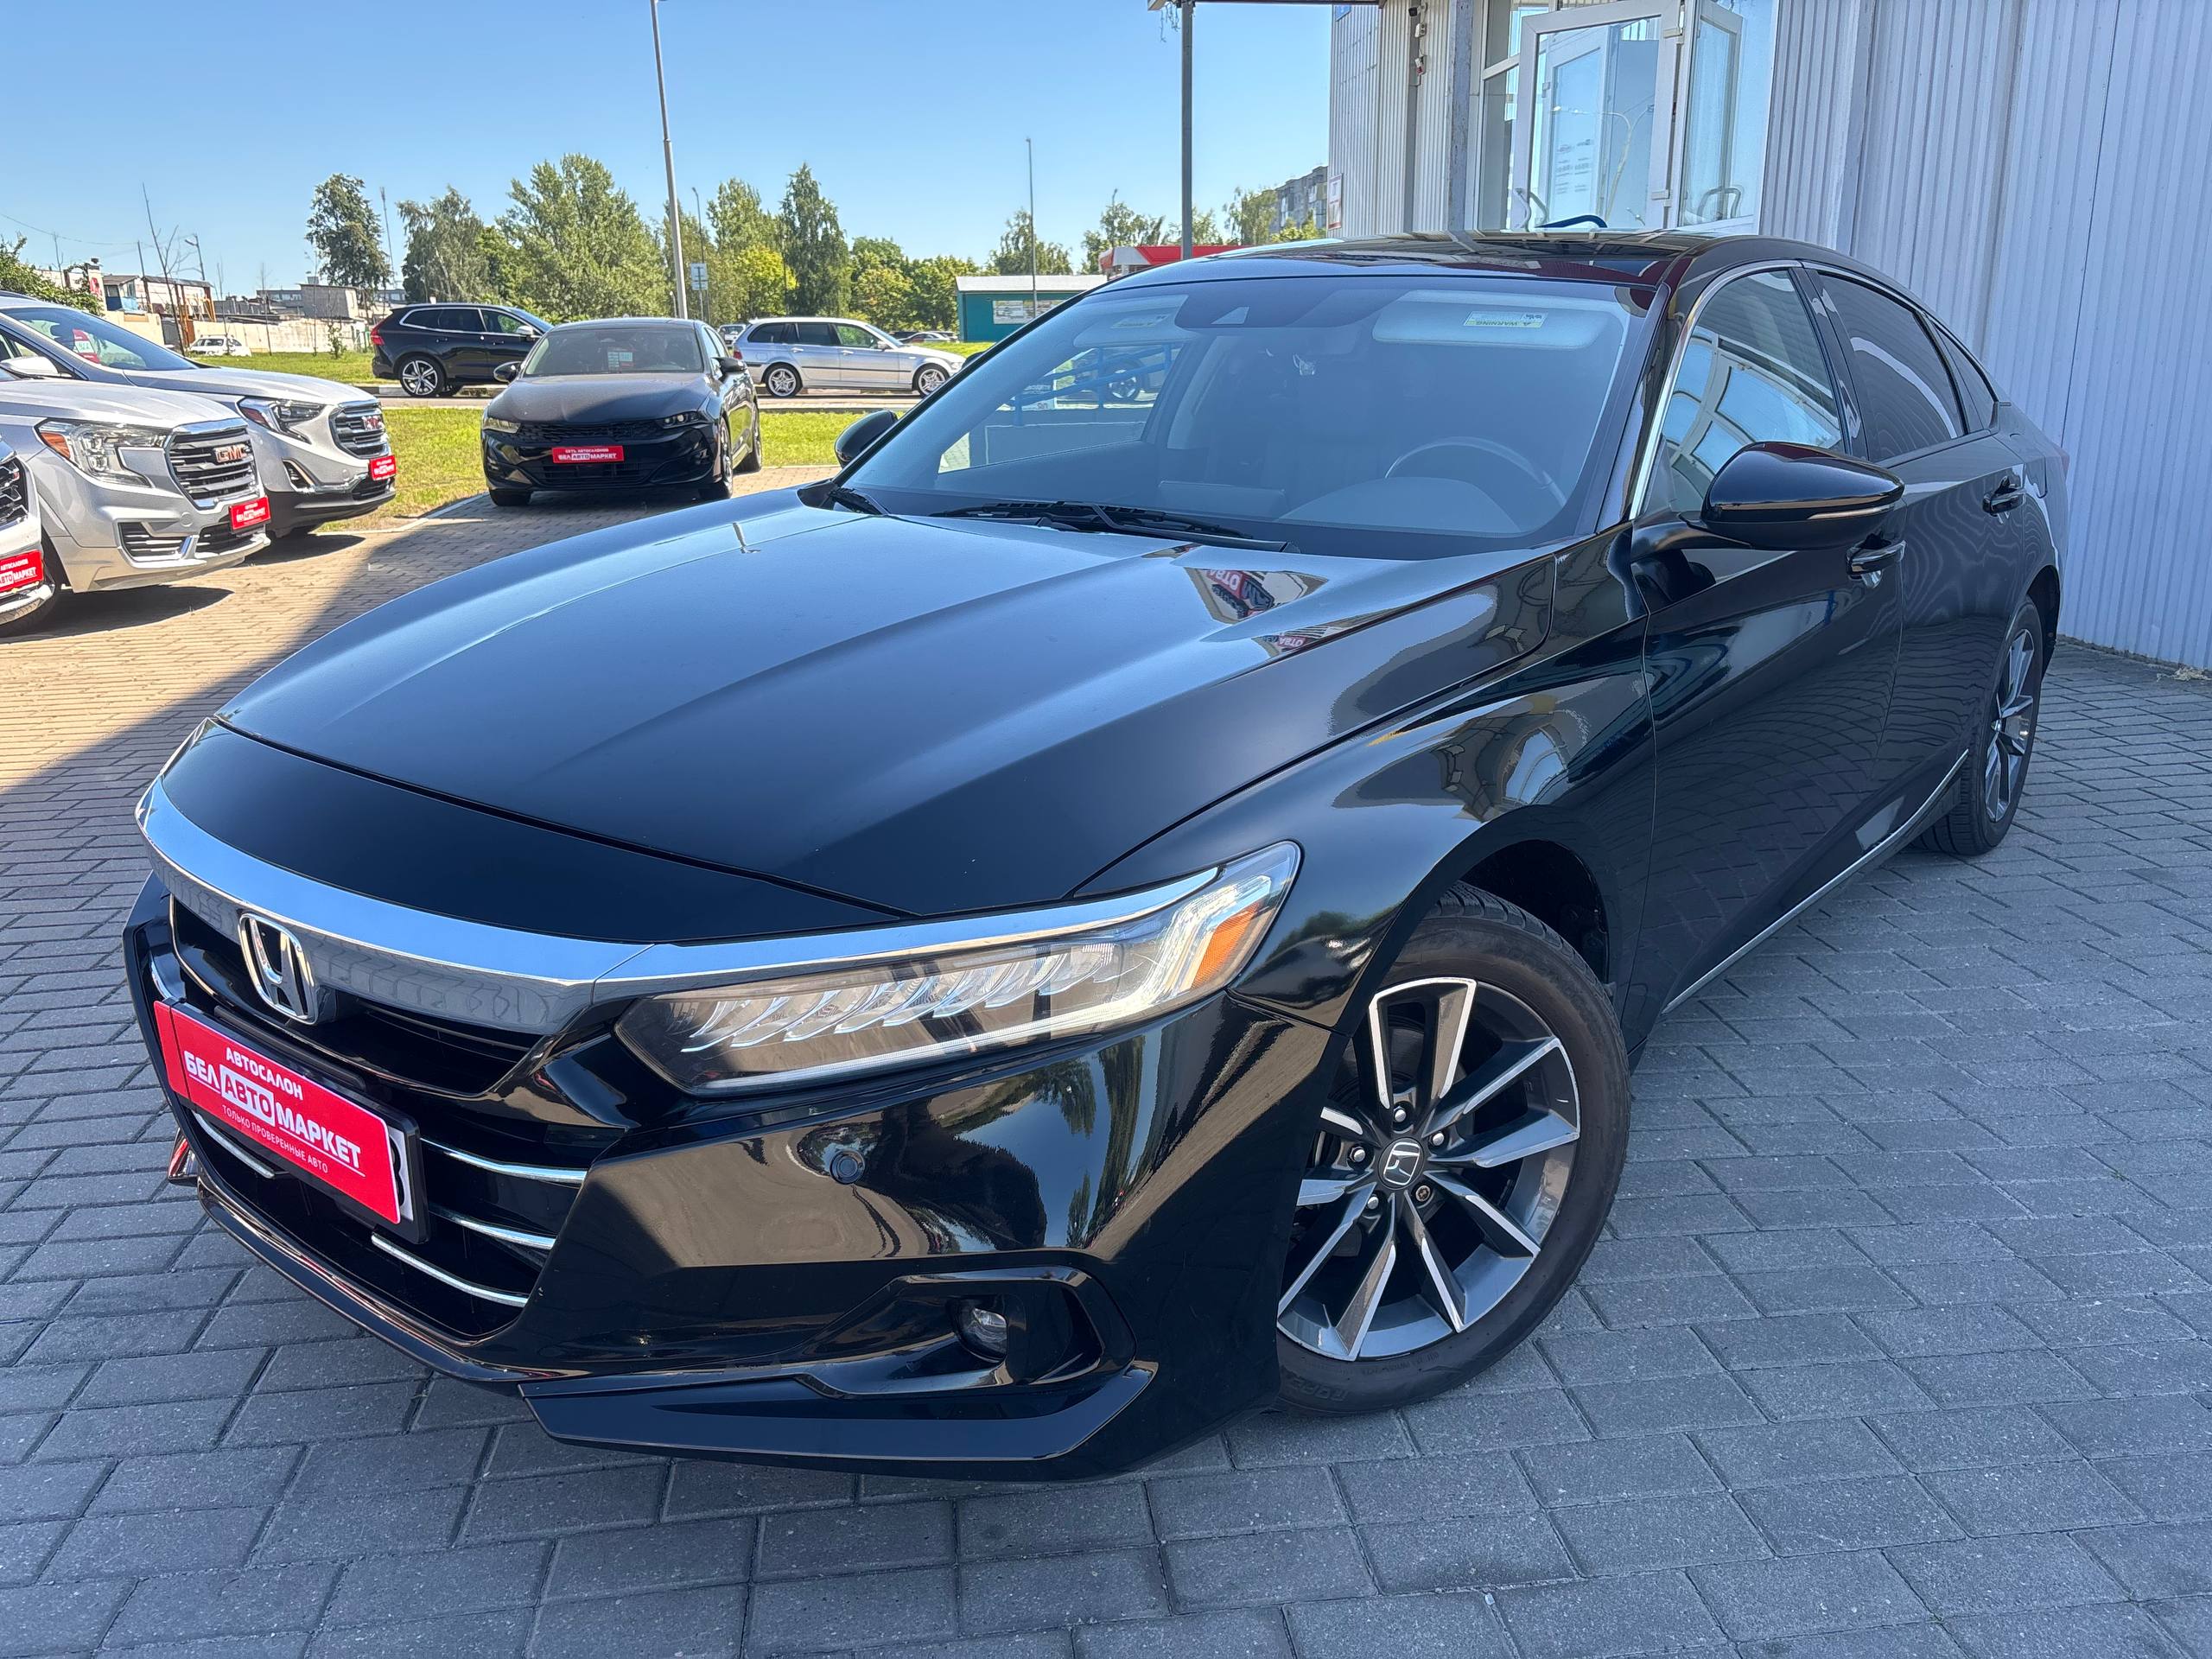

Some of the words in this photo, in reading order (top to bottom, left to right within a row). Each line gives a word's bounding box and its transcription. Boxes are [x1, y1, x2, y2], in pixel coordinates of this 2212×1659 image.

[213, 444, 250, 462] GMC
[226, 1046, 303, 1101] АВТОСАЛОН
[221, 1104, 251, 1129] ТОЛЬКО
[251, 1122, 307, 1161] ПРОВЕРЕННЫЕ
[307, 1154, 329, 1174] АВТО
